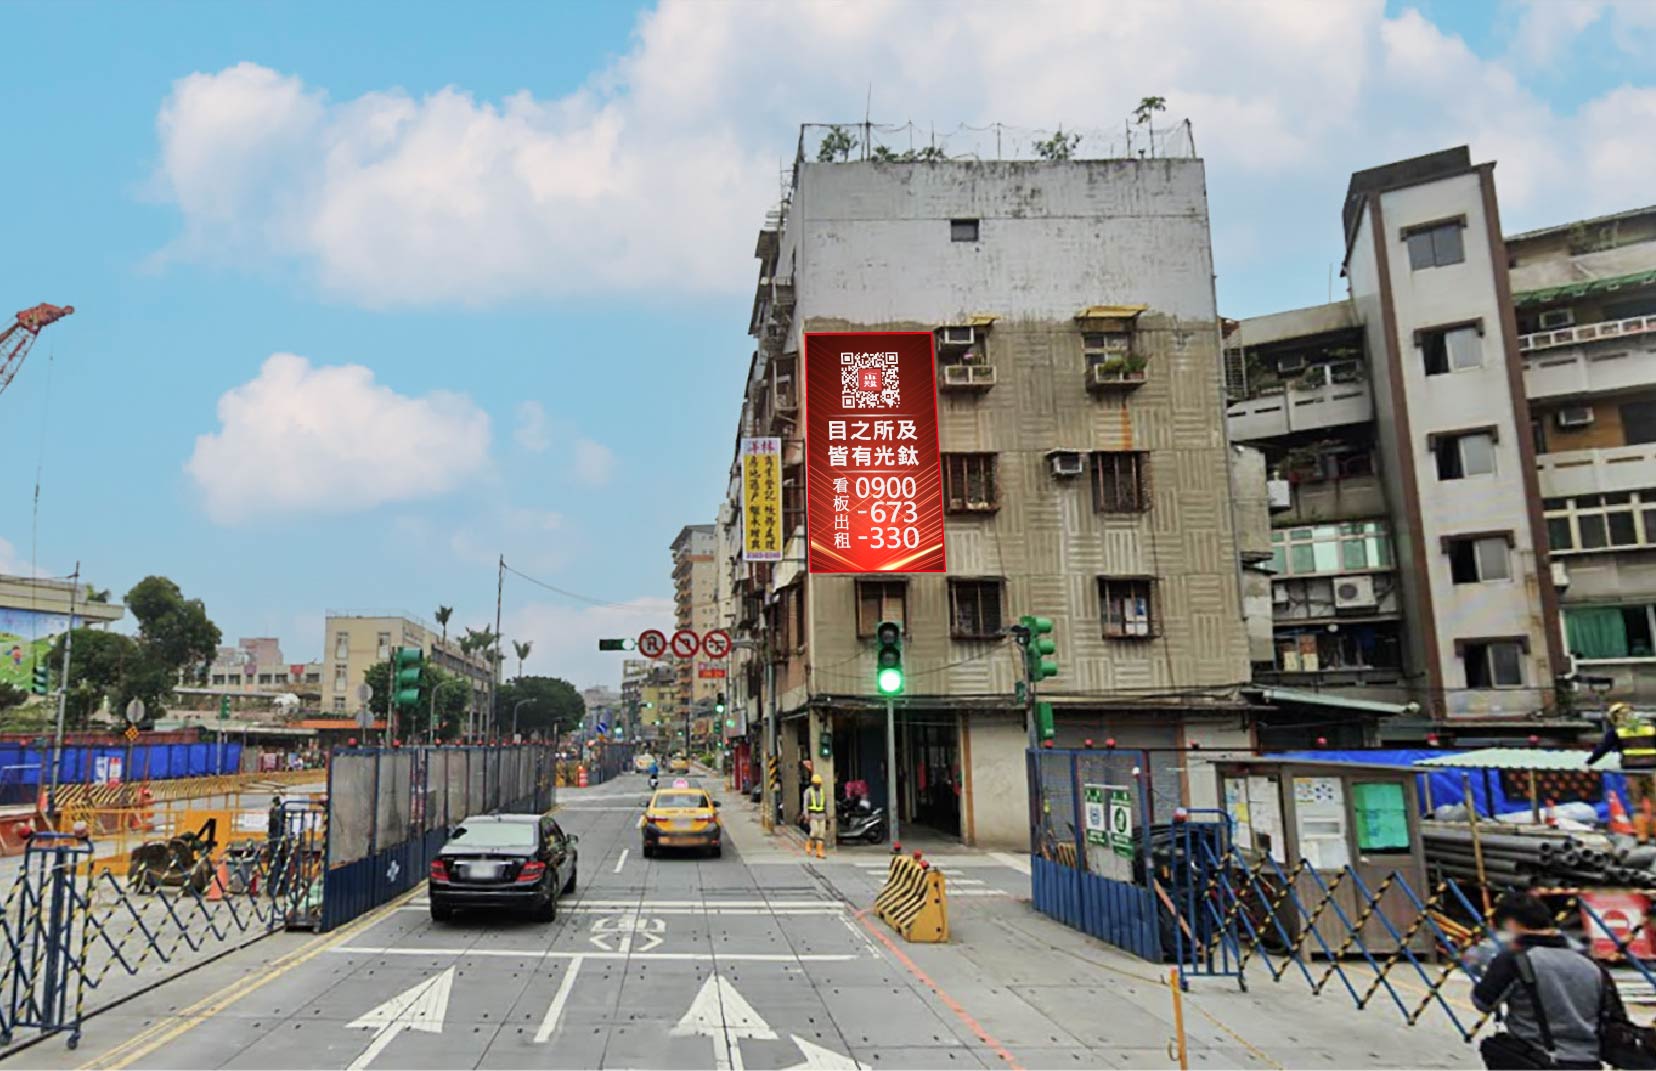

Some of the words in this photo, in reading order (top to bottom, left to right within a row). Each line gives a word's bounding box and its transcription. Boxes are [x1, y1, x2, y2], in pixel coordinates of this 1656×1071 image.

[828, 420, 918, 441] 目之所及
[828, 445, 919, 467] 皆有光鈦
[855, 476, 917, 498] 0900
[833, 477, 851, 549] 看板出租
[857, 501, 918, 523] -673
[858, 526, 920, 549] -330
